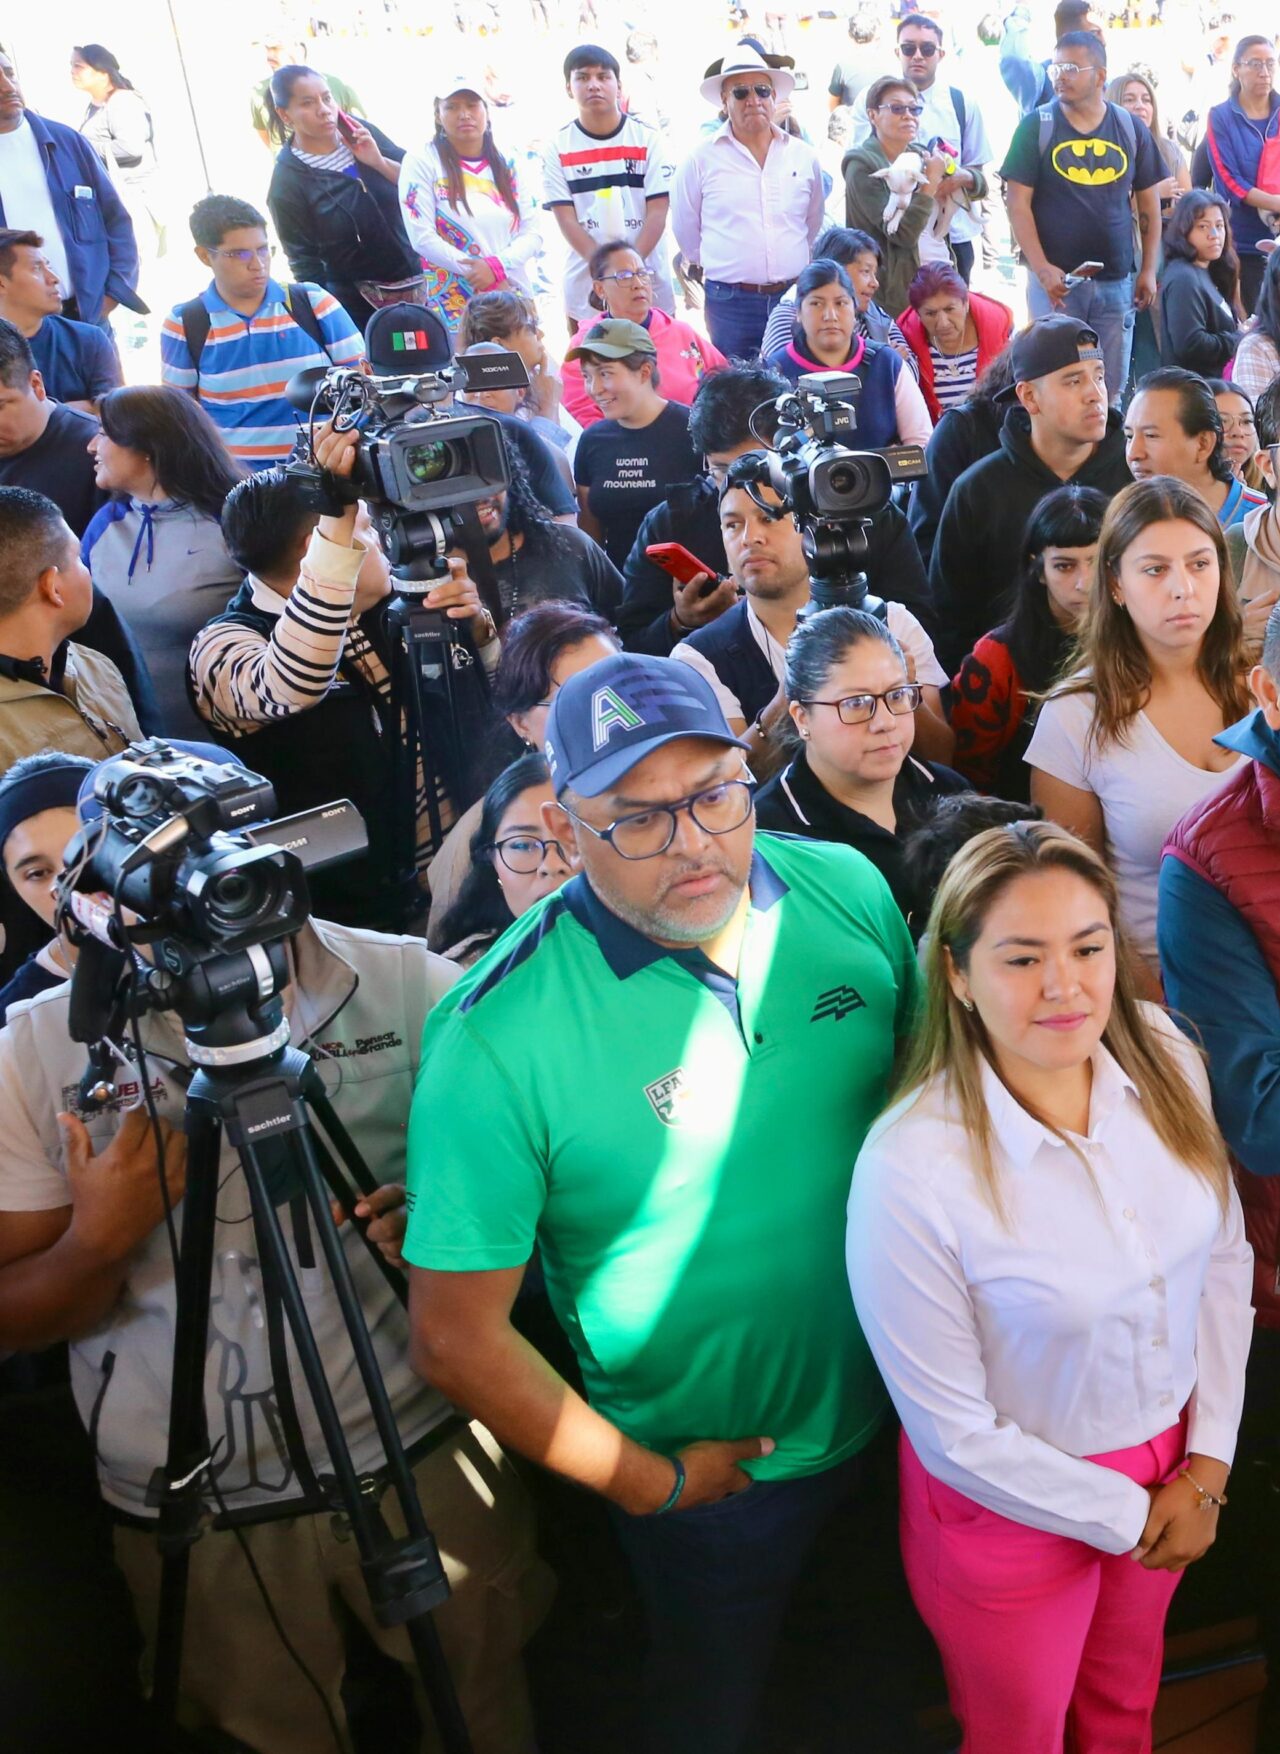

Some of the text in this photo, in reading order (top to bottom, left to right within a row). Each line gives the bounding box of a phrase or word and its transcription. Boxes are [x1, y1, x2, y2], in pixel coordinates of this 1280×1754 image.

[835, 417, 849, 425] JVC
[592, 685, 647, 753] A
[231, 804, 256, 817] SONY
[322, 806, 347, 818] SONY
[355, 1032, 395, 1050] Pensar
[651, 1076, 682, 1101] LFA
[248, 1114, 291, 1134] sachtler
